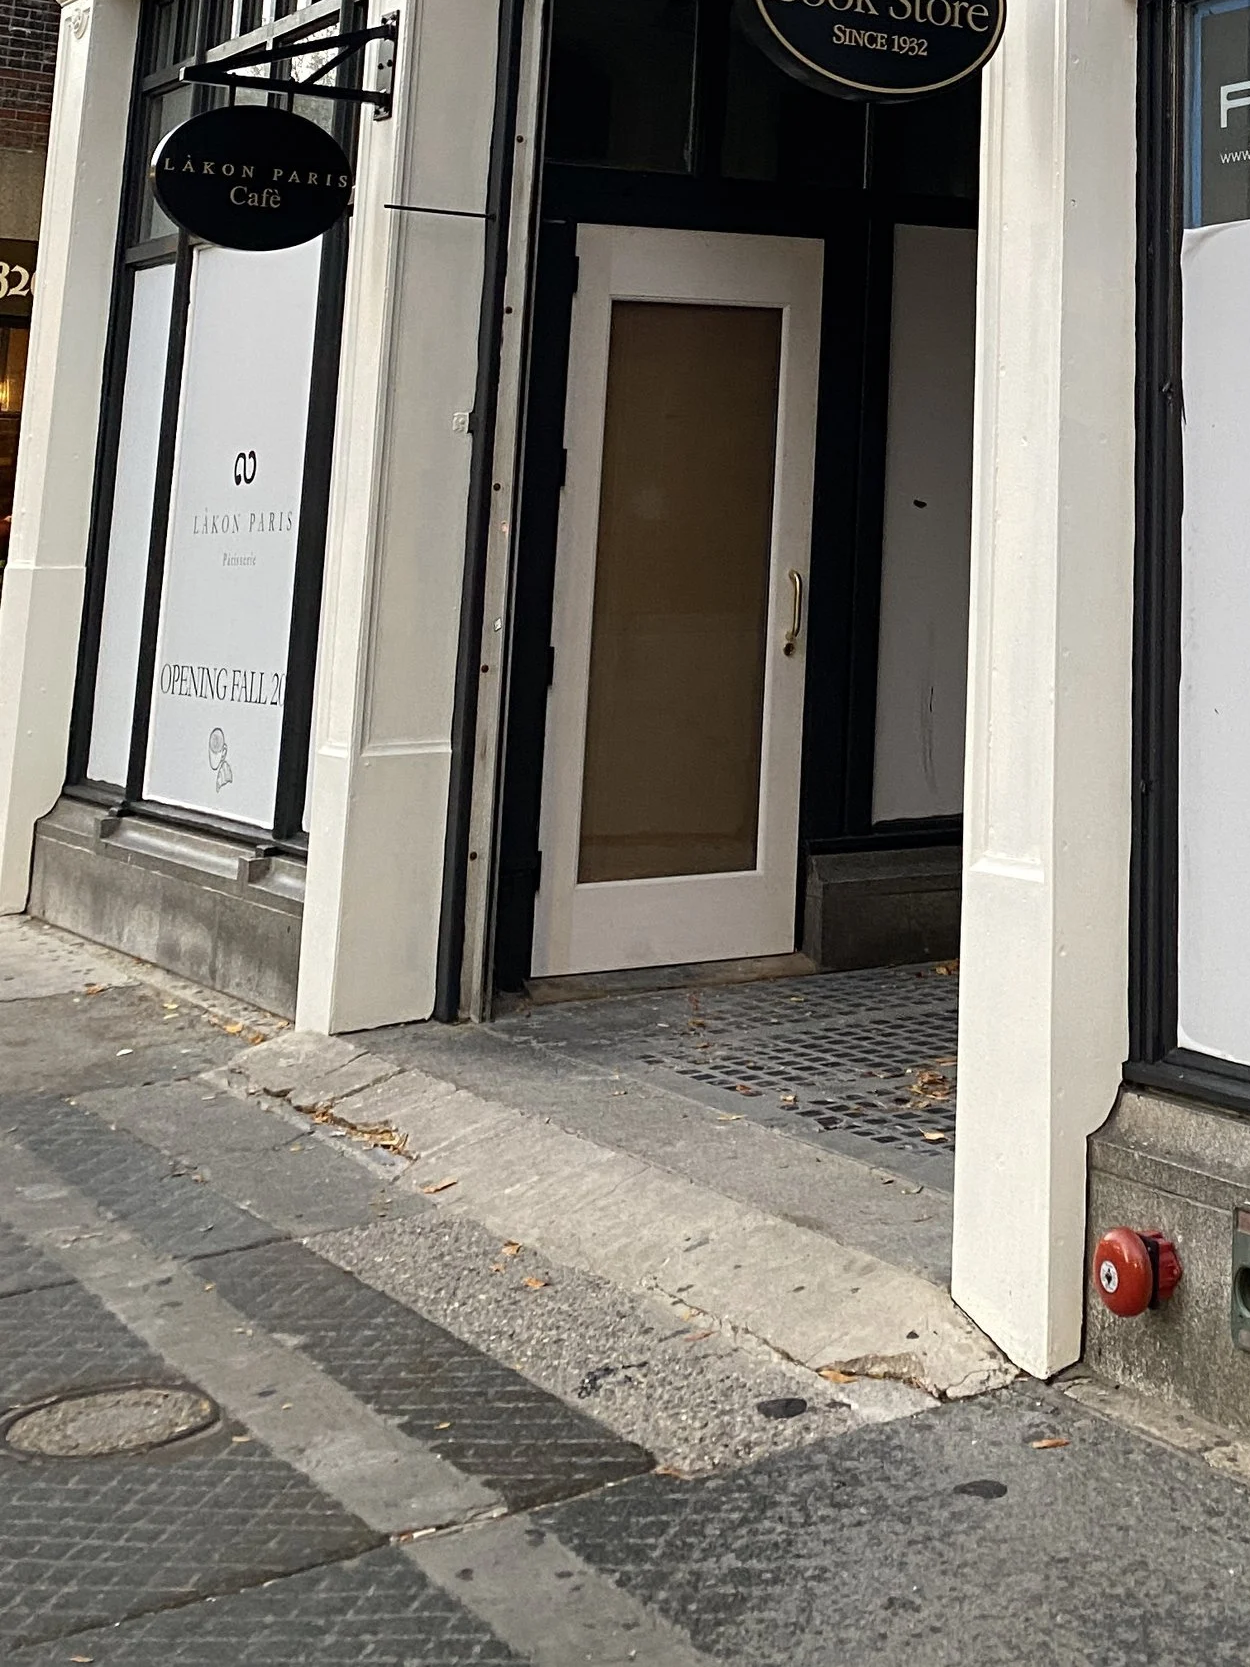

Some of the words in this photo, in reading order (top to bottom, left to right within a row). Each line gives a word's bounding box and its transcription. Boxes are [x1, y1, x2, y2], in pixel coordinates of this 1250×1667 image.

[832, 24, 887, 51] SINCE
[891, 35, 928, 57] 1932
[273, 168, 348, 188] PARIS
[249, 511, 293, 533] PARIS
[160, 663, 228, 701] OPENING
[230, 669, 268, 705] FALL
